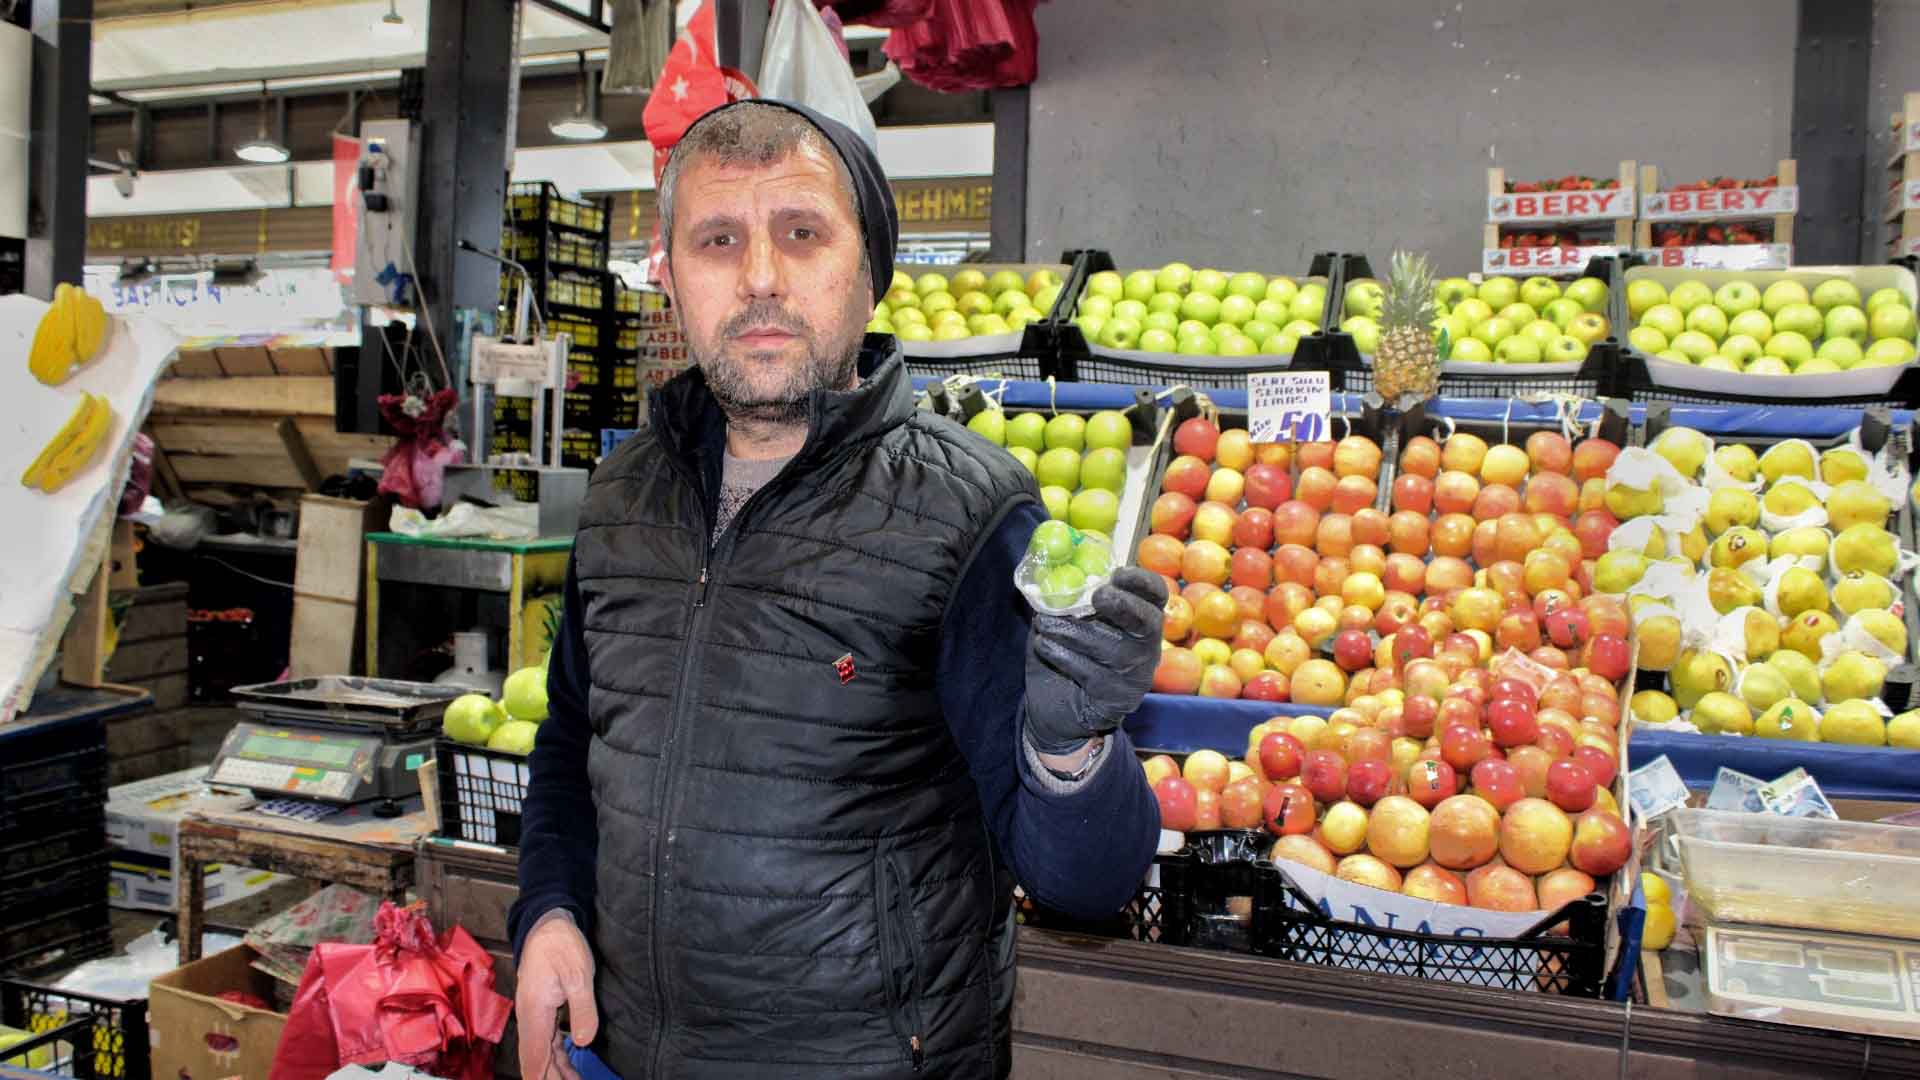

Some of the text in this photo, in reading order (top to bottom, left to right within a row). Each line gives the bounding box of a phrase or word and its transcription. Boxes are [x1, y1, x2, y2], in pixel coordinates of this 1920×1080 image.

[896, 187, 992, 221] EHME
[1515, 192, 1616, 217] BERY
[1668, 190, 1772, 212] BERY
[652, 311, 673, 323] BE
[1275, 411, 1323, 442] 50
